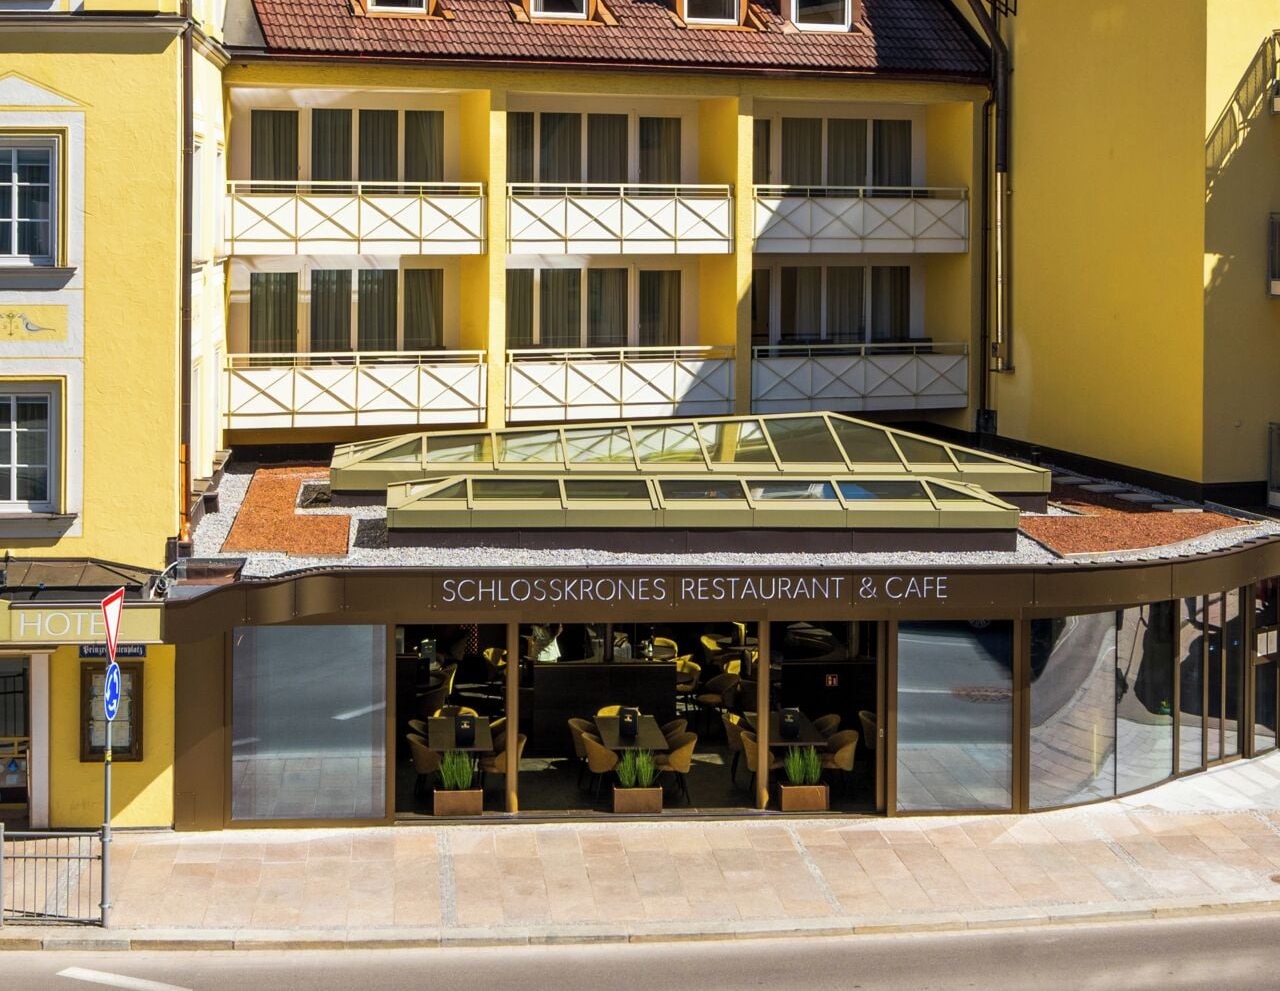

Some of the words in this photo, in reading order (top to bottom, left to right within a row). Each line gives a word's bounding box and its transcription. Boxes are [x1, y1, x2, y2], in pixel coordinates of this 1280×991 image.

[442, 579, 666, 602] SCHLOSSKRONES
[681, 577, 845, 600] RESTAURANT
[859, 576, 877, 599] &
[885, 576, 948, 599] CAFE
[20, 611, 125, 637] HOTE
